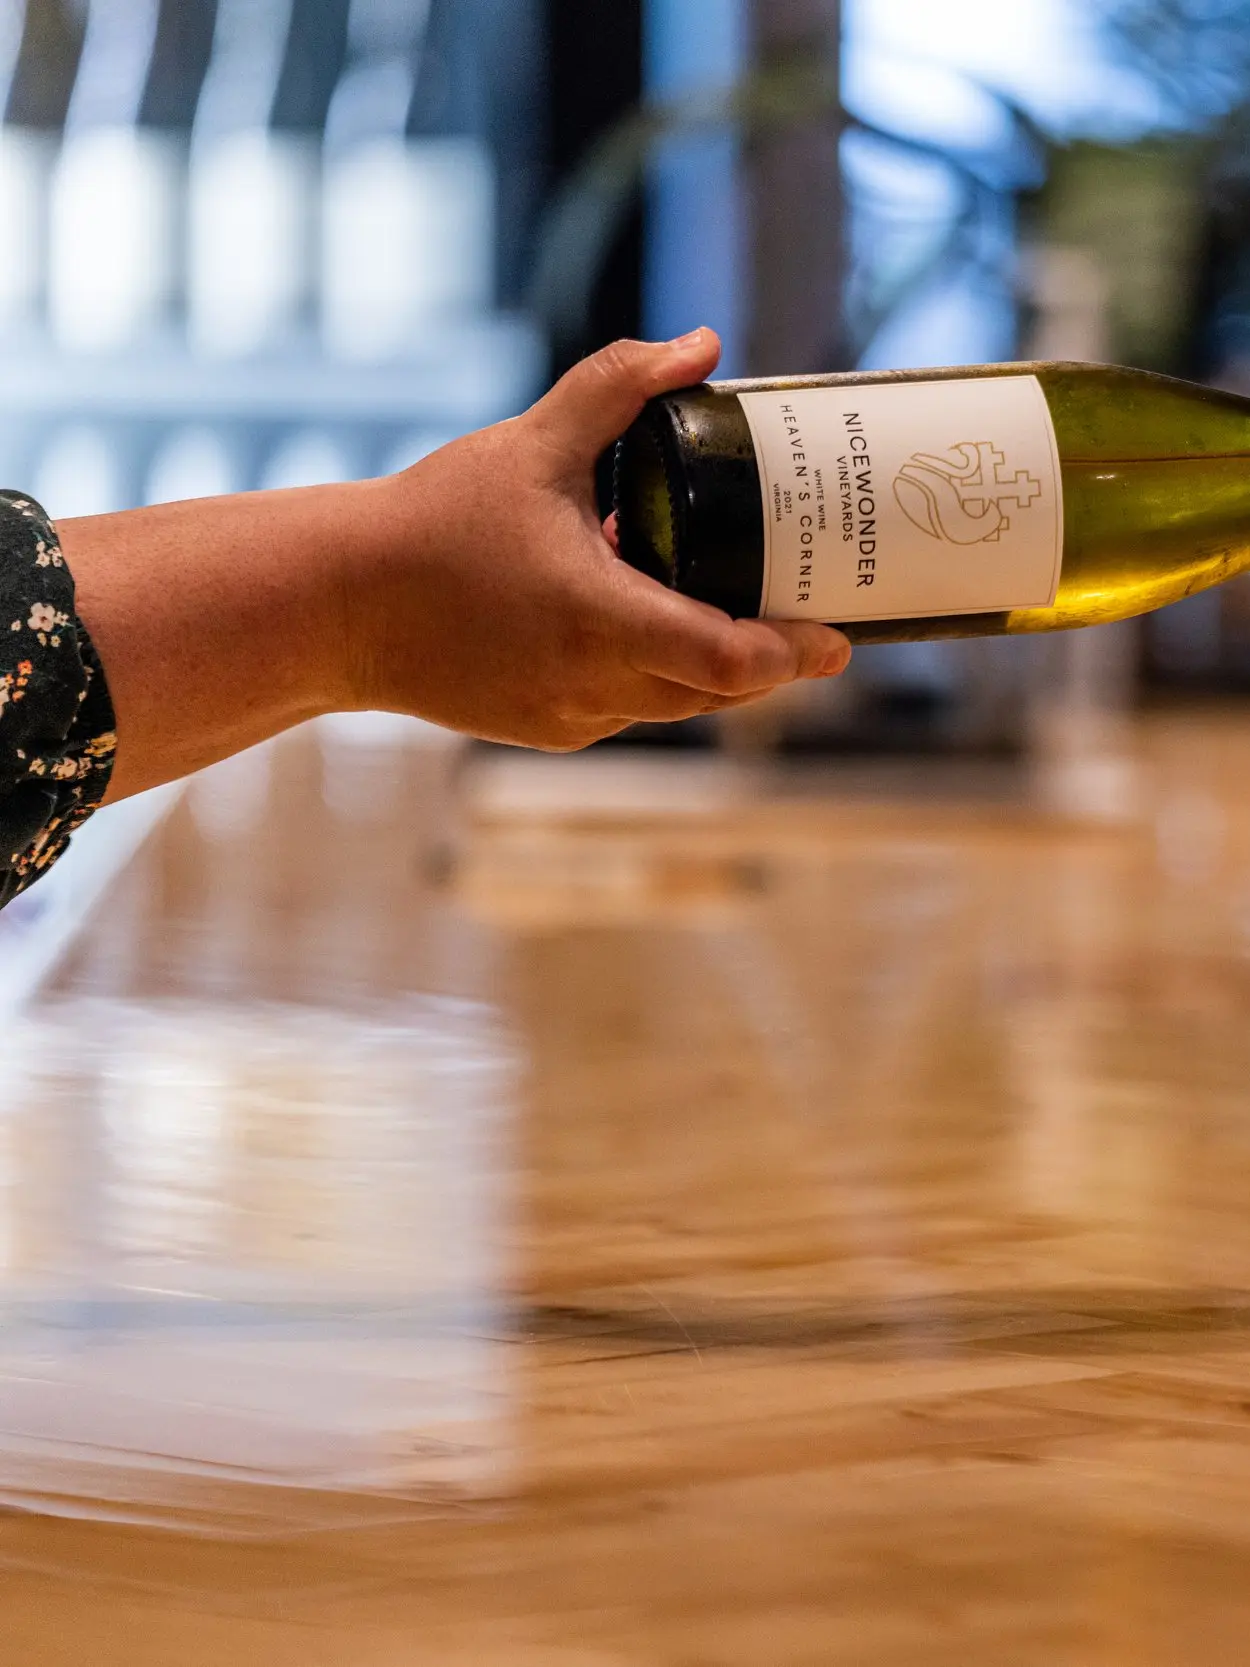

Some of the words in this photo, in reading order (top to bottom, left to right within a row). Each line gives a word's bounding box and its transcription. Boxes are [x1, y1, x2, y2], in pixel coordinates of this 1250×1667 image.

[773, 483, 782, 522] VIRGINIA
[780, 405, 811, 502] HEAVEN'S
[796, 515, 812, 602] CORNER
[783, 490, 792, 514] 2021
[814, 469, 825, 501] WHITE
[836, 455, 853, 542] VINEYARDS
[843, 413, 876, 588] NICEWONDER
[818, 504, 826, 531] WINE
